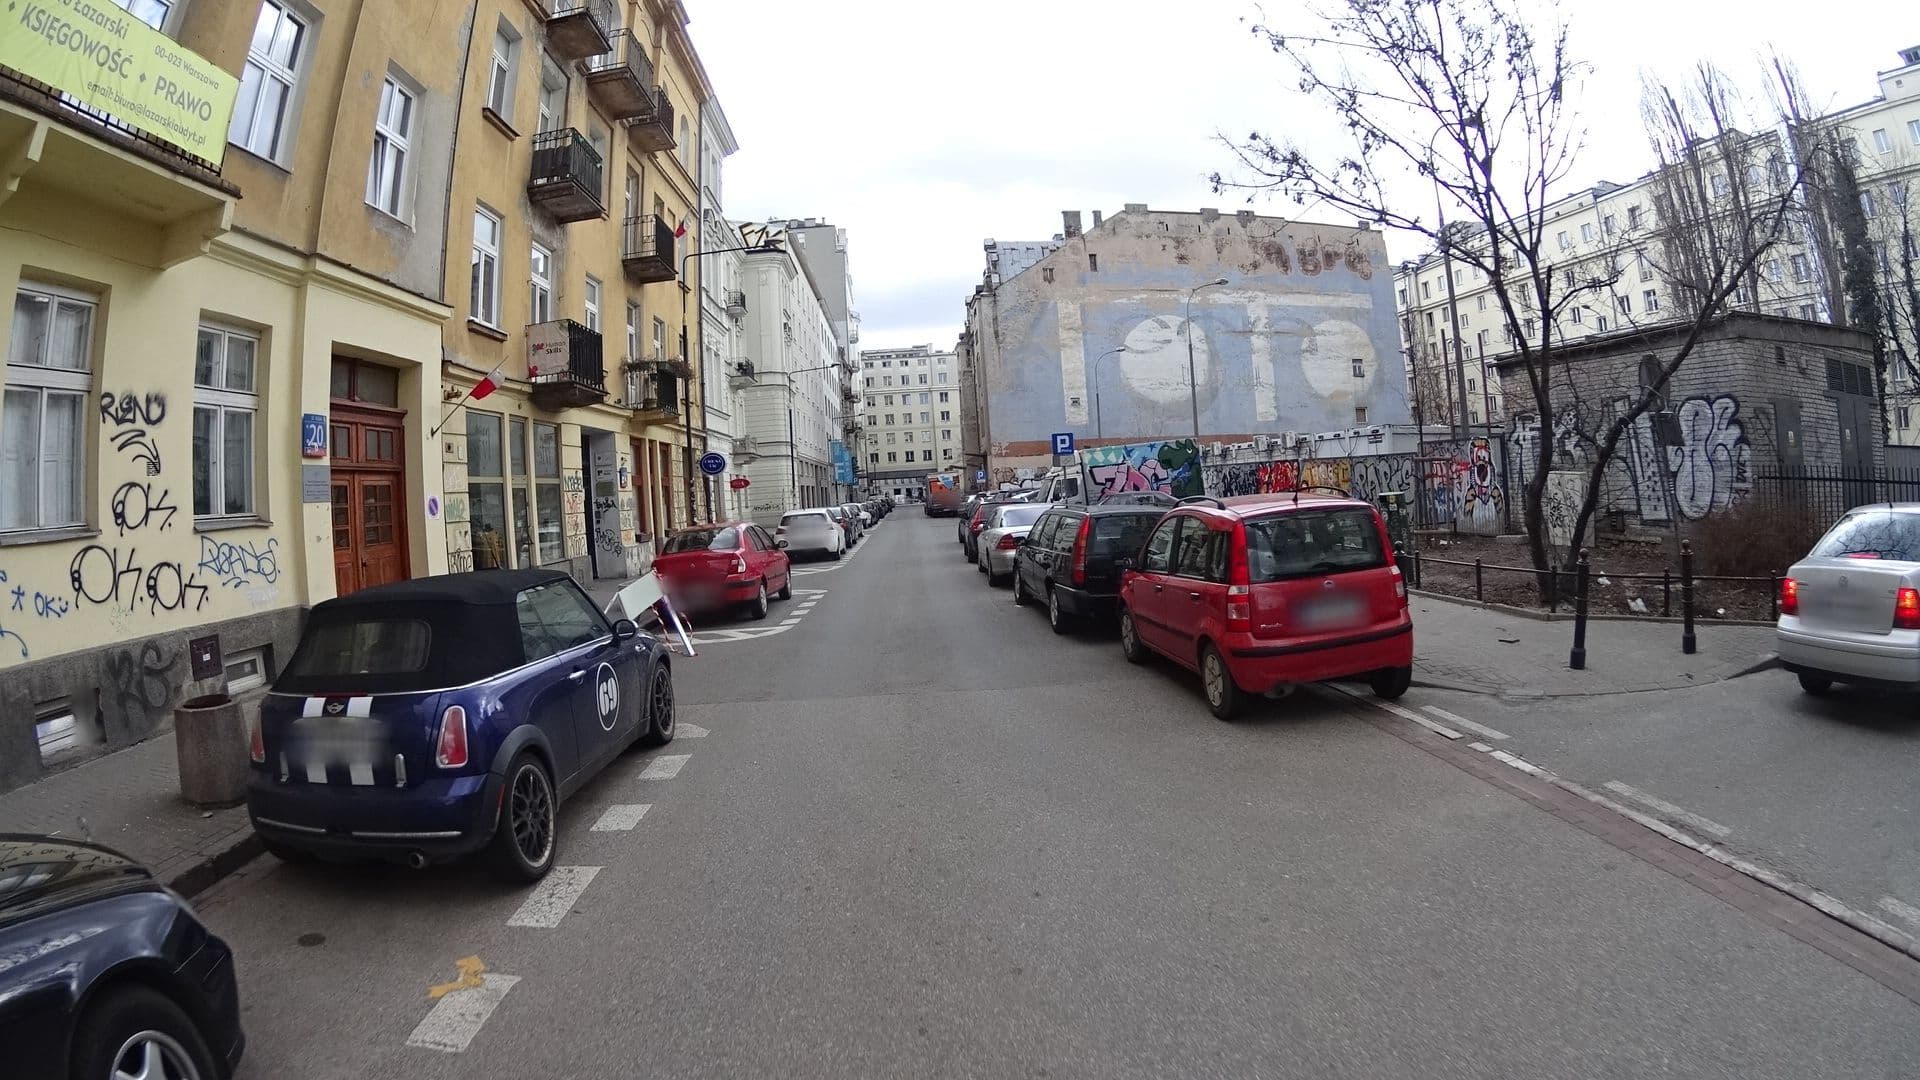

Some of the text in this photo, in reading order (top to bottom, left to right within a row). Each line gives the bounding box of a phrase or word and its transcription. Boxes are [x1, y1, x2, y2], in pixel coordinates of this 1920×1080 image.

[20, 2, 213, 122] KSIĘGOWOŚĆ PRAWO
[154, 44, 220, 91] 00-023 Warszawa
[1056, 435, 1070, 453] P
